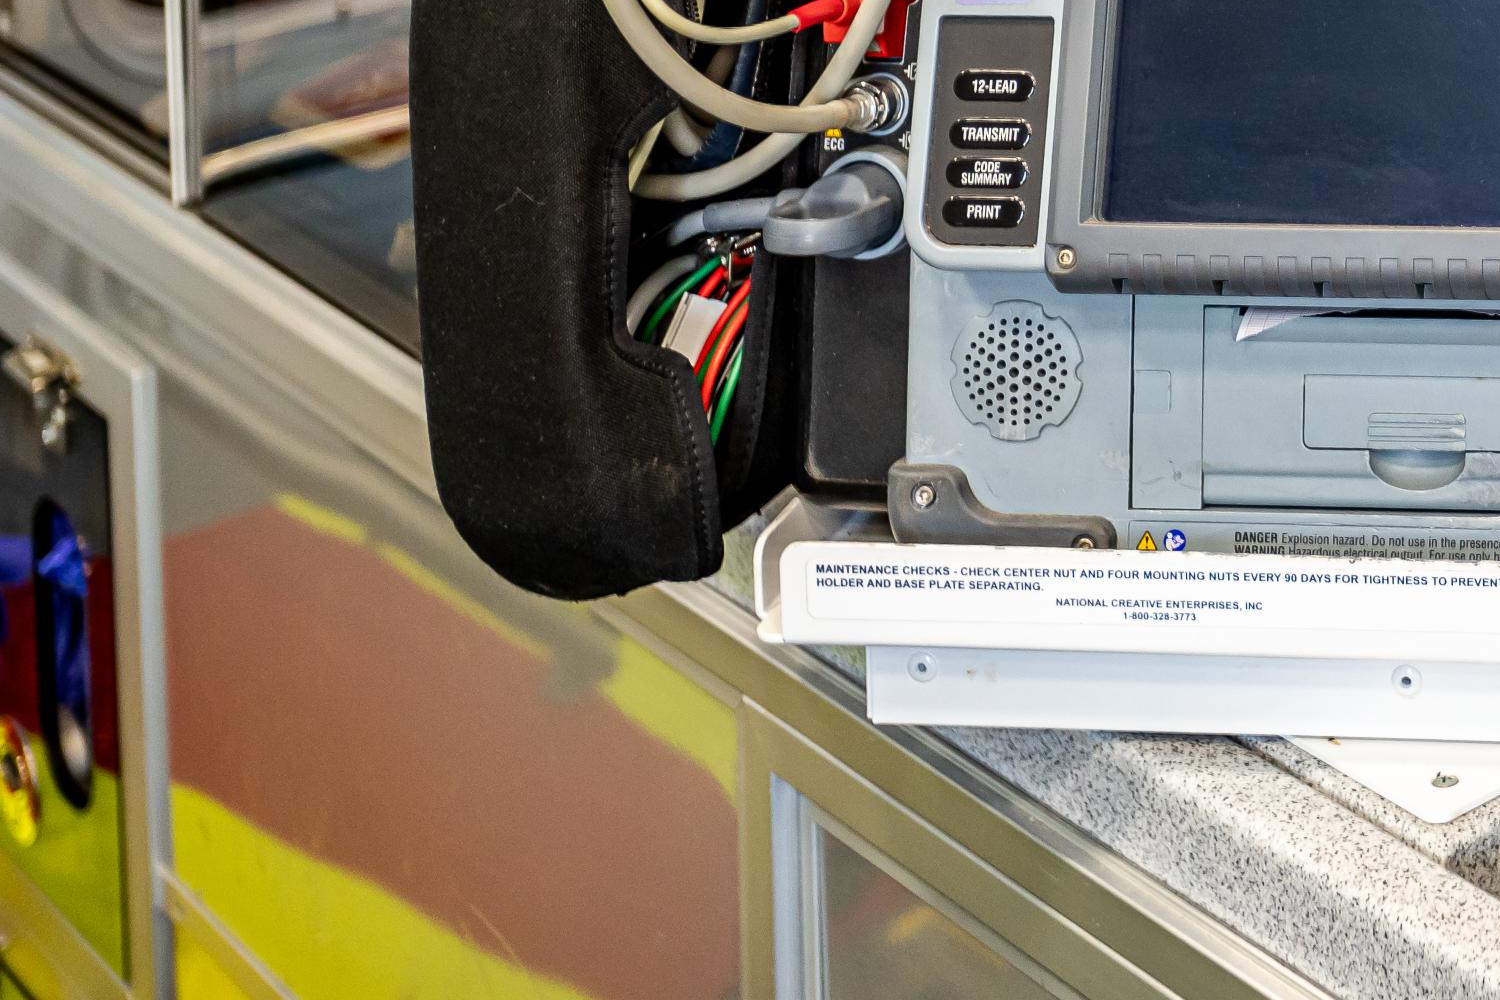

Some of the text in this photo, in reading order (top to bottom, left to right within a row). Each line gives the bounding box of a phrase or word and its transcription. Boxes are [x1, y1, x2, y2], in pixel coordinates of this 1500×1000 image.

[971, 79, 1018, 94] 12-LEAD
[961, 126, 1020, 142] TRANSMIT
[823, 137, 845, 151] ECG
[973, 161, 1001, 173] CODE
[960, 172, 1012, 186] SUMMARY
[966, 204, 1002, 220] PRINT
[1234, 531, 1278, 544] DANGER
[1281, 533, 1330, 549] Explosion
[1332, 534, 1369, 547] hazard.
[1371, 534, 1386, 547] Do
[1388, 535, 1405, 548] not
[1408, 538, 1426, 548] use
[1428, 535, 1438, 548] in
[1440, 536, 1457, 549] the
[1234, 545, 1285, 556] WARNING
[1429, 549, 1446, 561] For
[1448, 551, 1466, 561] use
[815, 563, 899, 575] MAINTENANCE
[902, 565, 950, 576] CHECKS
[960, 566, 1000, 578] CHECK
[1003, 567, 1050, 578] CENTER
[1053, 568, 1077, 579] NUT
[1079, 569, 1105, 580] AND
[1107, 569, 1140, 580] FOUR
[1142, 570, 1206, 582] MOUNTING
[1208, 572, 1241, 582] NUTS
[1243, 572, 1282, 583] EVERY
[1284, 572, 1298, 583] 90
[1300, 573, 1332, 584] DAYS
[1334, 574, 1360, 584] FOR
[1362, 574, 1429, 586] TIGHTNESS
[1432, 576, 1448, 587] TO
[815, 577, 1044, 592] HOLDER AND BASE PLATE SEPARATING.
[1055, 598, 1264, 611] NATIONAL CREATIVE ENTERPRISES, INC
[1122, 611, 1197, 622] 1-800-328-3773
